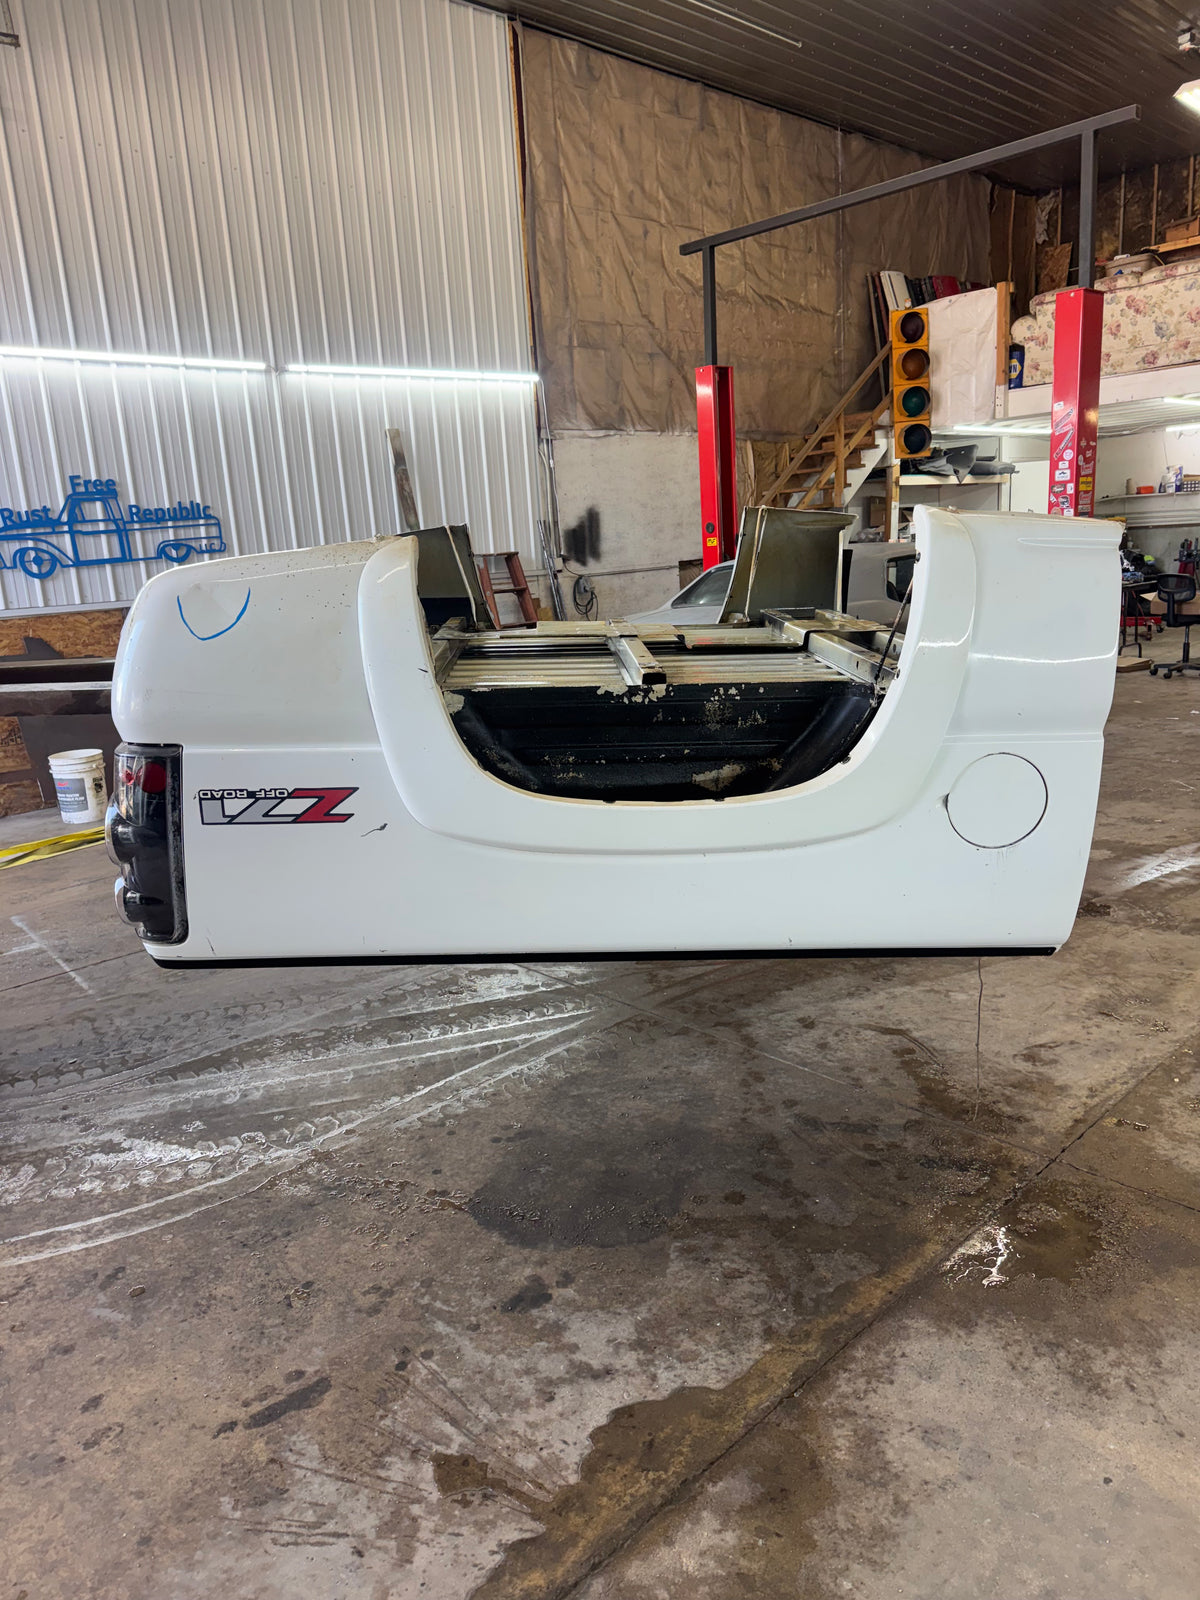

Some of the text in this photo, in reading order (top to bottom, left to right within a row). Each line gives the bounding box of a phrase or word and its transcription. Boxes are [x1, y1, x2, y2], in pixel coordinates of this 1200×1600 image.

[1, 475, 211, 526] Rust Free Republic
[199, 788, 289, 799] OFF ROAD
[199, 787, 360, 825] Z71
